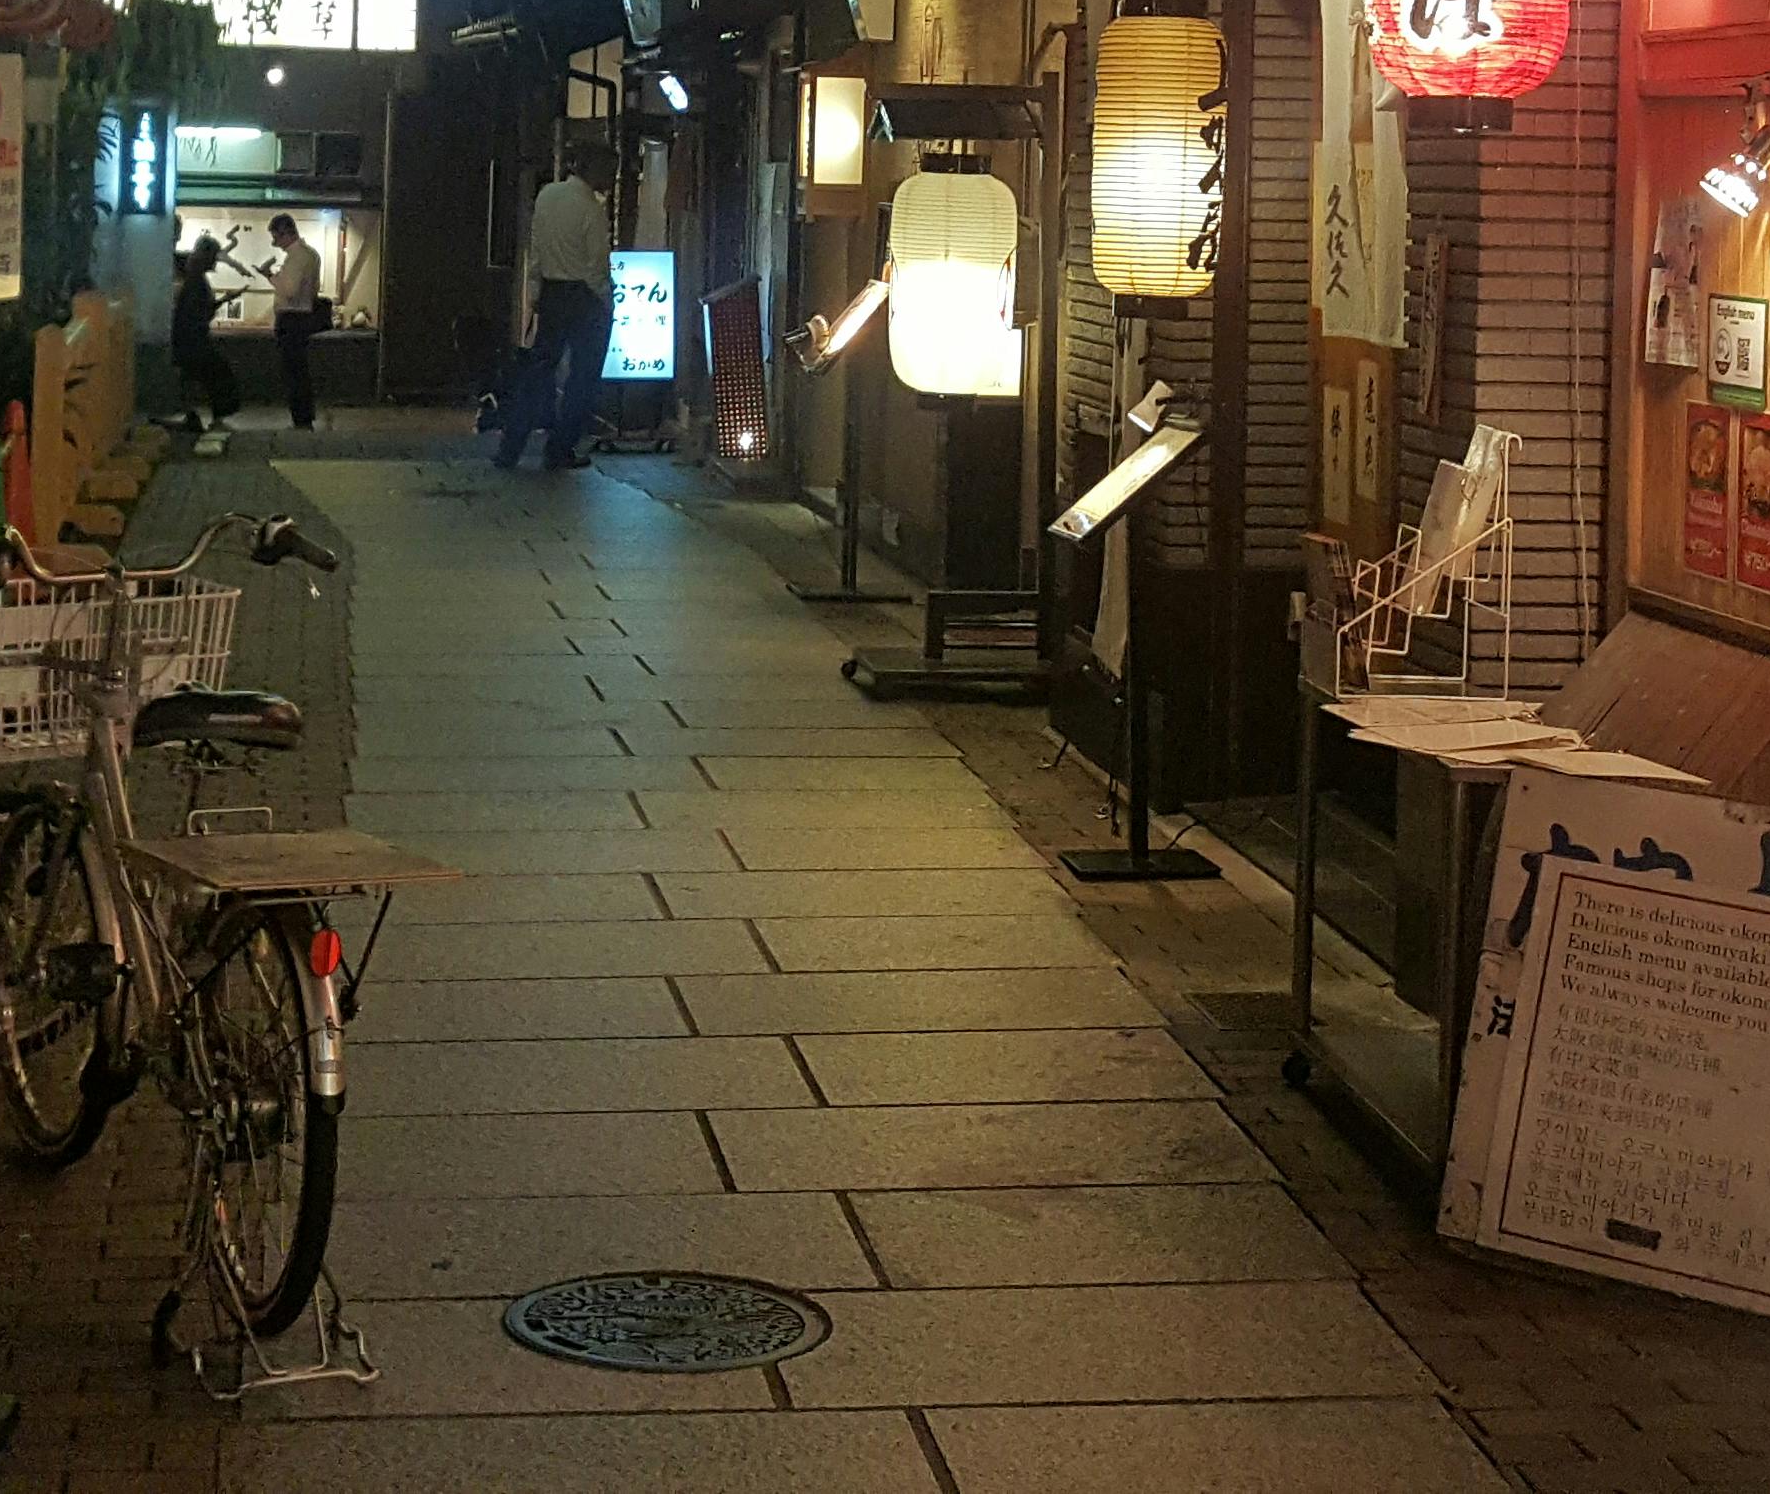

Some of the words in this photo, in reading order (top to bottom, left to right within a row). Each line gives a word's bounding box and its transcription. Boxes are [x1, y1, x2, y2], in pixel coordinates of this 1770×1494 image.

[1570, 913, 1648, 942] Delicious
[1575, 891, 1624, 917] There
[1629, 903, 1644, 918] is
[1649, 907, 1725, 935] delicious
[1567, 934, 1632, 962] English
[1638, 951, 1686, 972] menu
[1563, 953, 1631, 981] Famous
[1636, 970, 1686, 994] shops
[1691, 981, 1716, 1001] for
[1561, 975, 1585, 995] We
[1590, 983, 1651, 1009] always
[1657, 996, 1732, 1025] welcome
[1736, 1012, 1768, 1036] you
